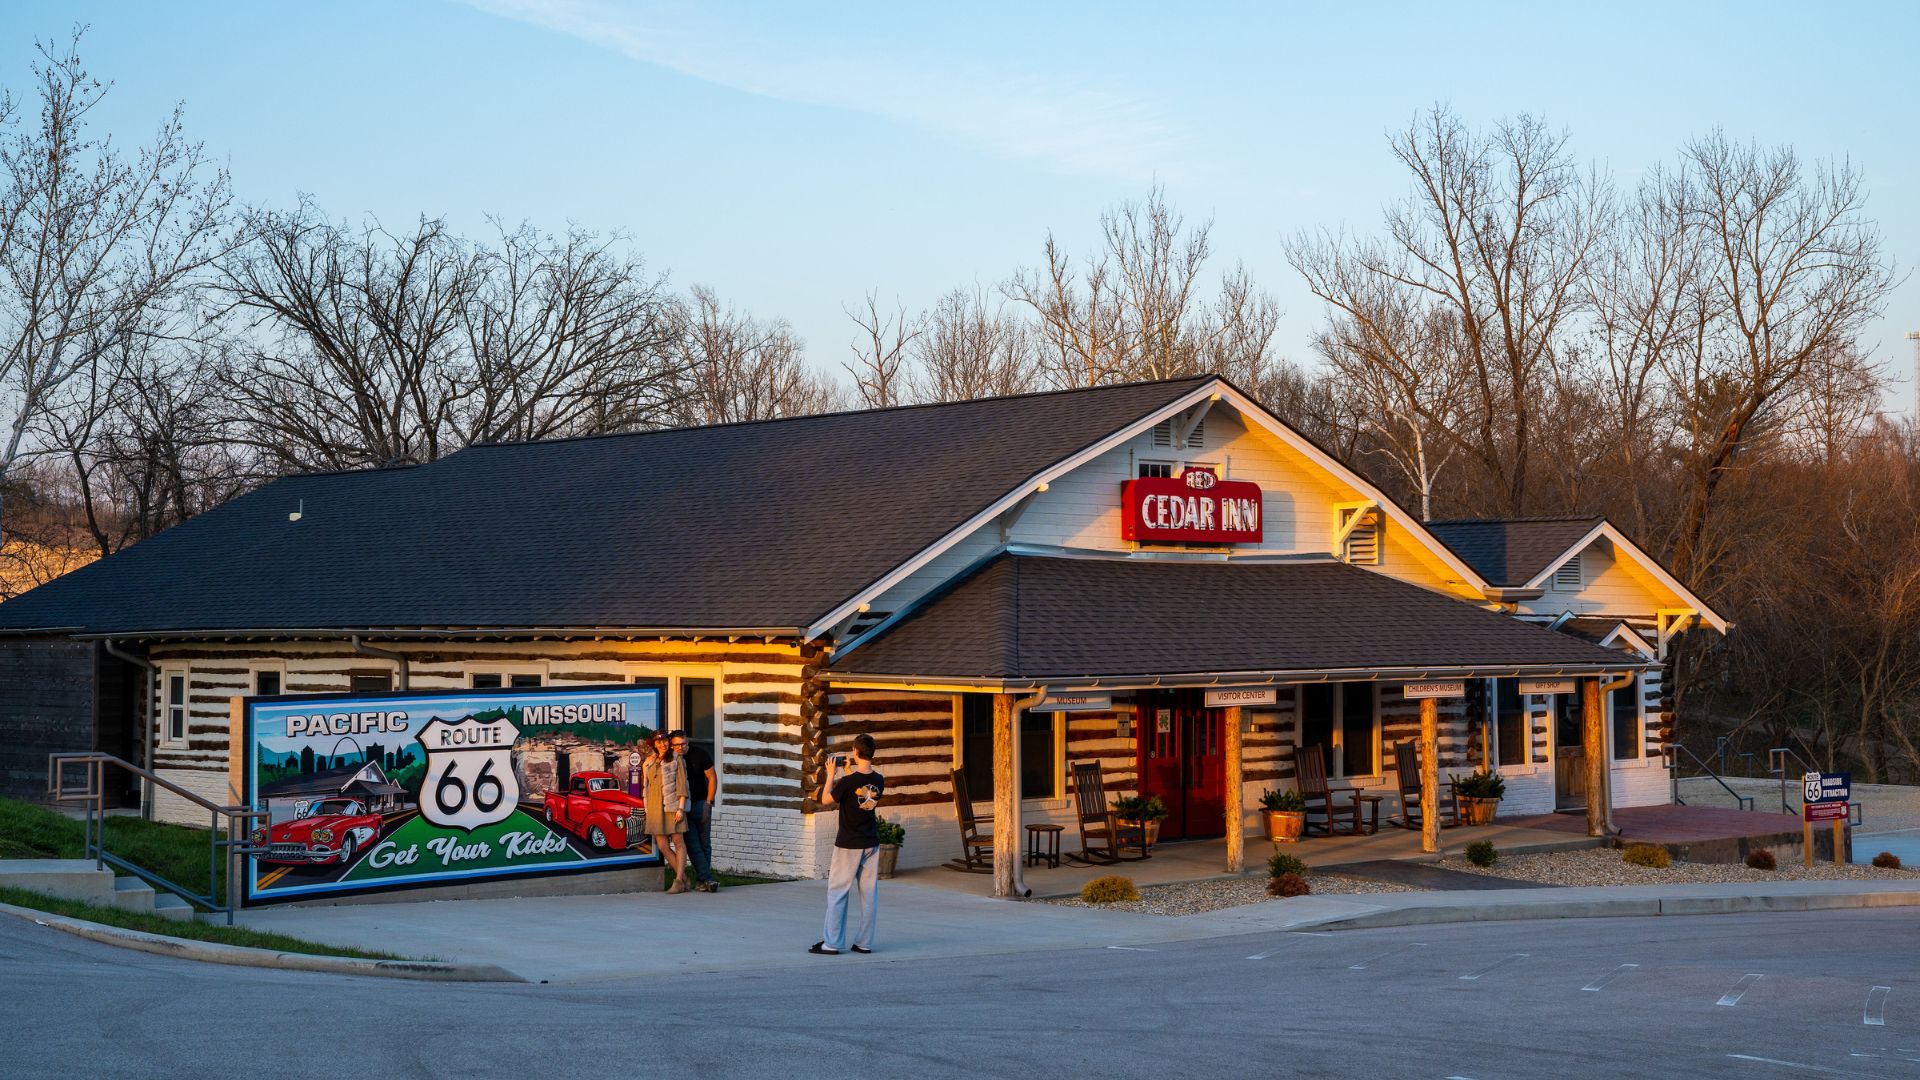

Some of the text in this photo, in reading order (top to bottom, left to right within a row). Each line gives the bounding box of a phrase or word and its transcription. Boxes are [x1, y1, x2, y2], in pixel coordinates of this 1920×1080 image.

[1186, 471, 1217, 489] RED
[1142, 494, 1258, 532] CEDAR INN
[1408, 683, 1462, 693] CHILDREN'S MUSEUM
[1547, 681, 1560, 689] SHOP
[1056, 696, 1088, 705] MUSEUM
[1217, 690, 1266, 701] VISITOR CENTER
[286, 711, 409, 737] PACIFIC
[522, 703, 627, 726] MISSOURI
[440, 726, 502, 747] ROUTE
[435, 758, 505, 816] 66
[1808, 782, 1819, 798] 66
[369, 831, 568, 869] Get Your Kicks
